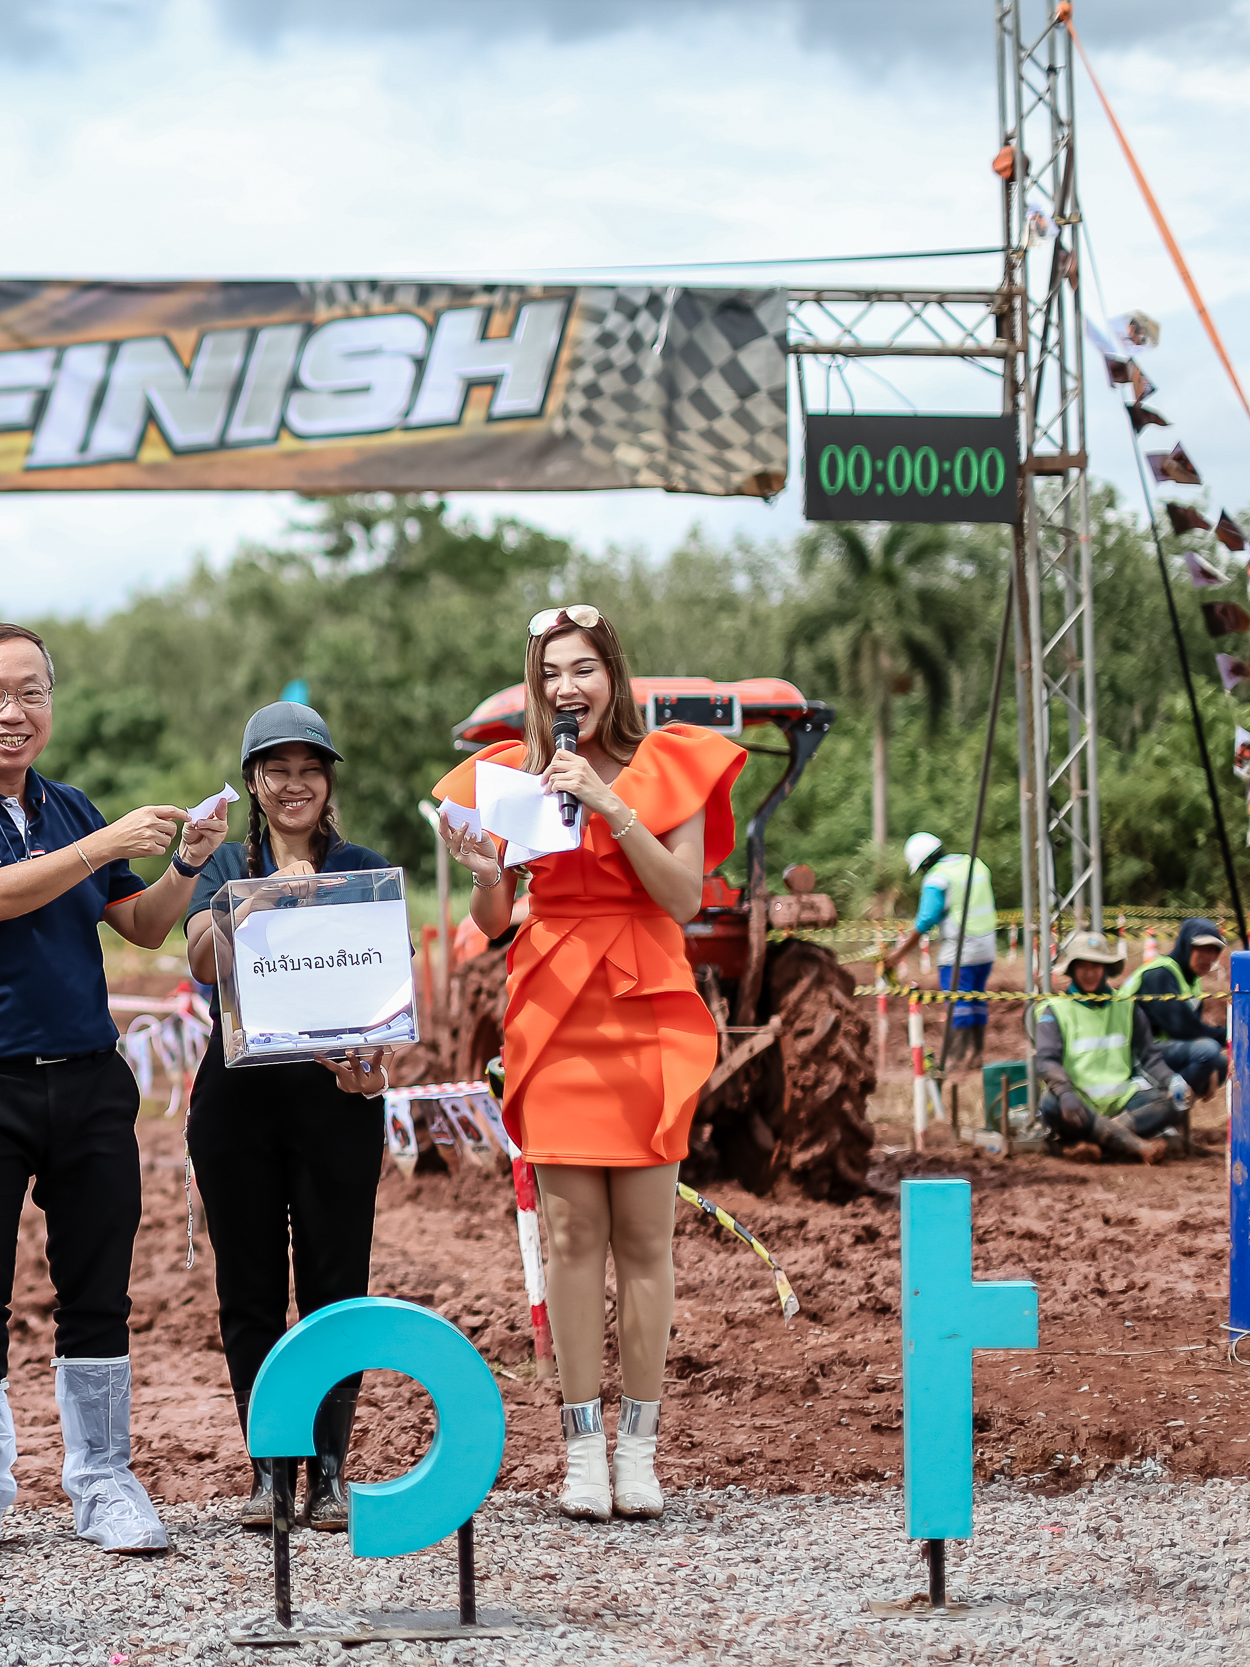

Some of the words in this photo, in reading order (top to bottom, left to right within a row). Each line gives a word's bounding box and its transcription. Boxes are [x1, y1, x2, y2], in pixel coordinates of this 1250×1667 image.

[819, 444, 1005, 497] 00:00:00
[253, 948, 383, 977] ลุ้นจับจองสินค้า
